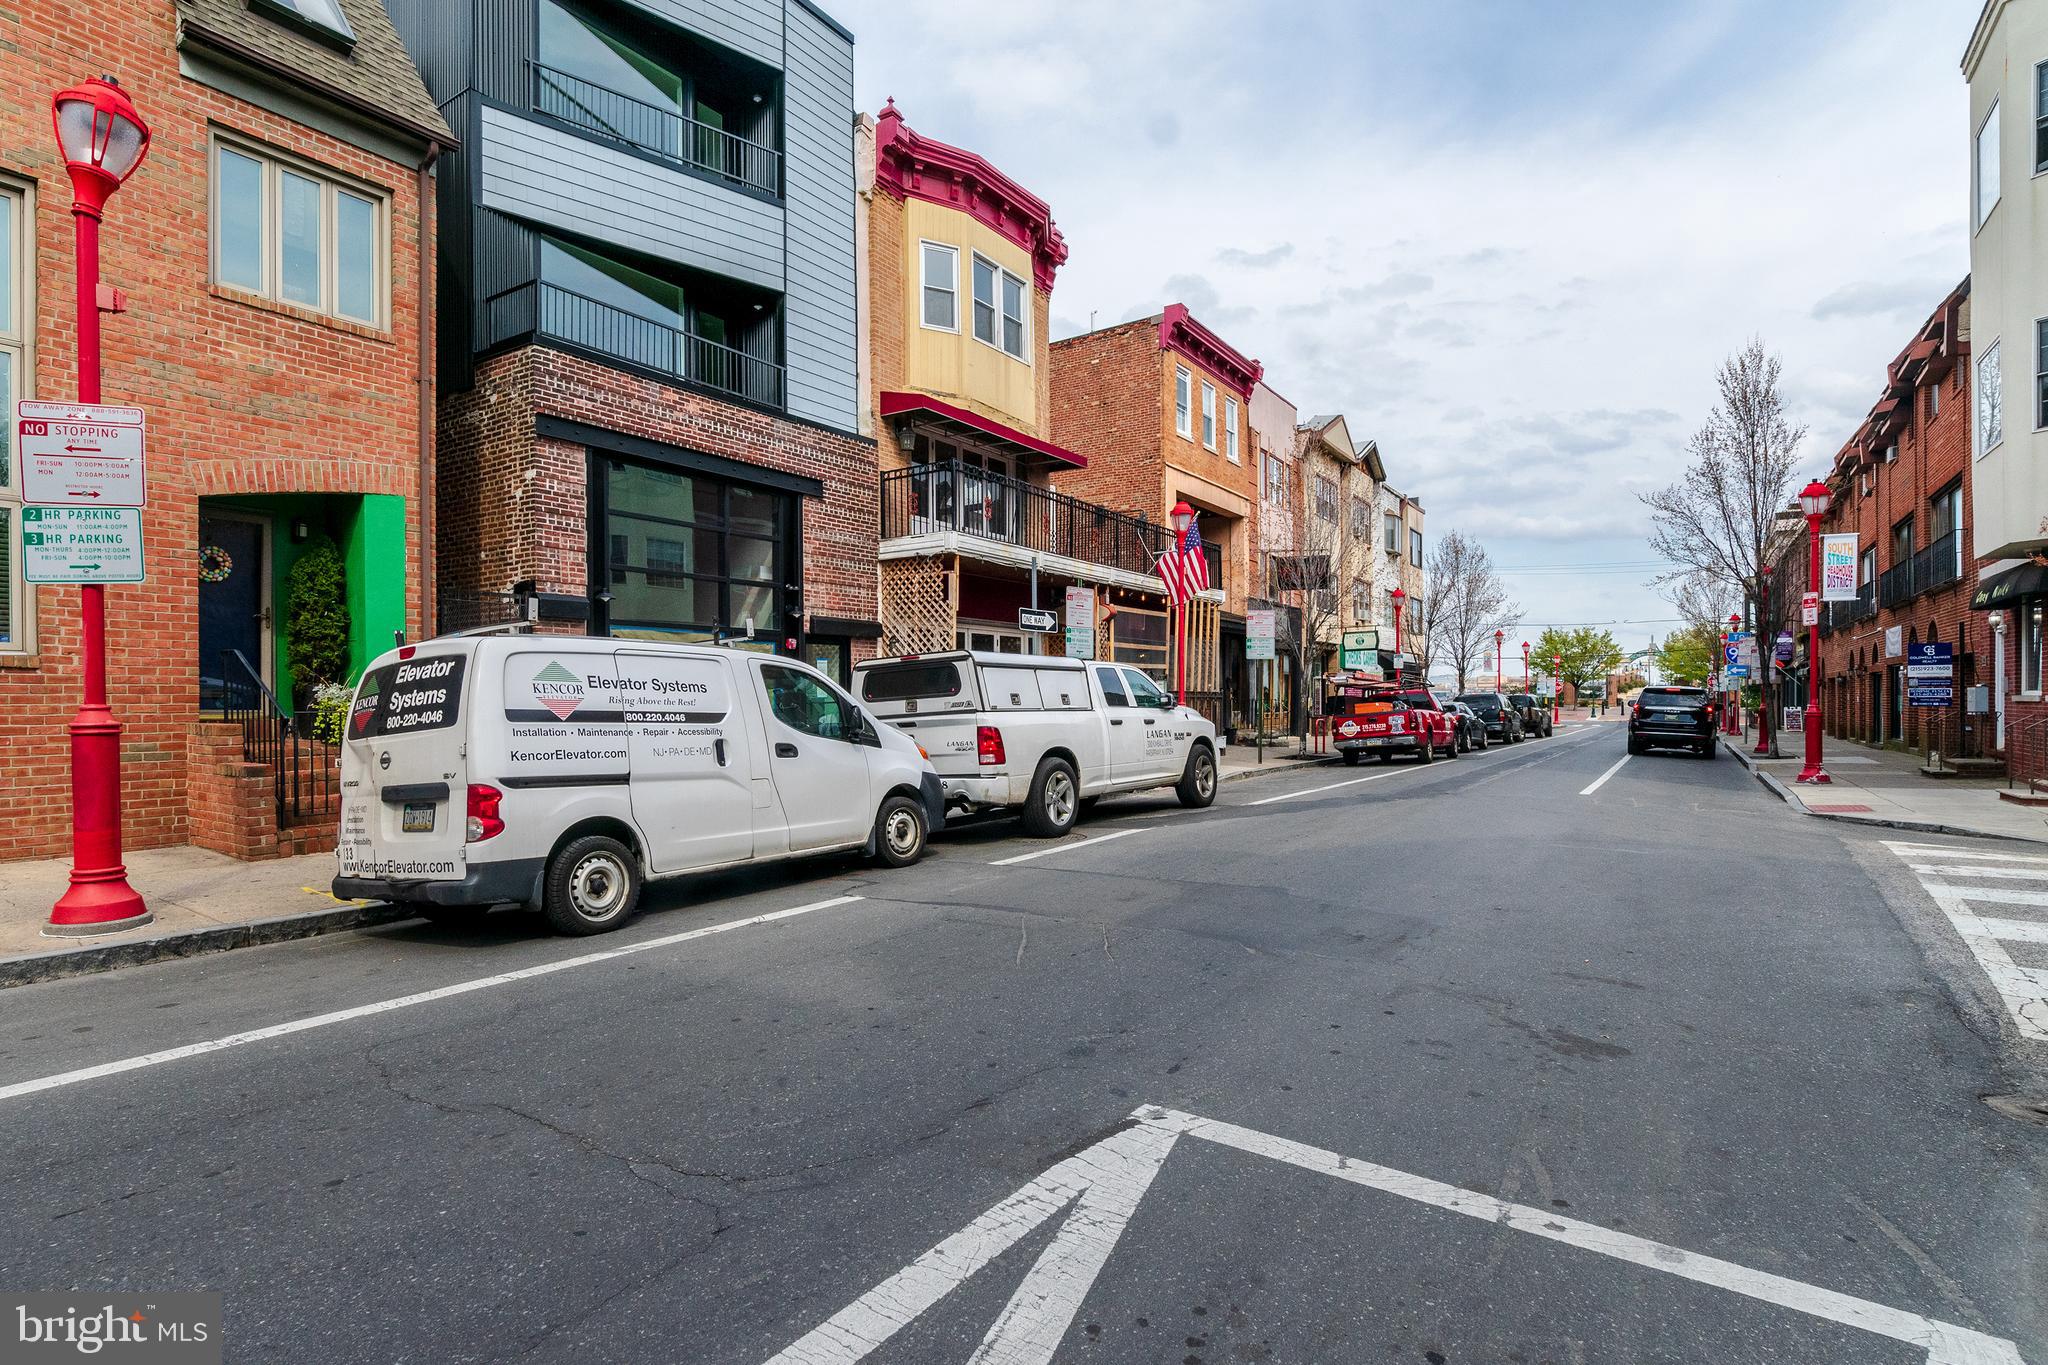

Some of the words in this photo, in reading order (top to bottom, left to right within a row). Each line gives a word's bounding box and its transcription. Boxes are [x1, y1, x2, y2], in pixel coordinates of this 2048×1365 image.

[25, 423, 45, 435] NO
[55, 425, 119, 439] STOPPING
[29, 510, 36, 520] 2
[44, 510, 60, 520] HR
[68, 510, 121, 520] PARKING
[31, 535, 38, 544] 3
[46, 534, 62, 544] HR
[69, 534, 123, 544] PARKING
[1827, 542, 1854, 556] SOUTH
[1827, 553, 1853, 565] STREET
[1827, 565, 1853, 578] HEADHOUSE
[1827, 574, 1853, 588] DISTRICT
[1023, 615, 1033, 624] ONE
[1034, 616, 1046, 624] WAY
[1729, 647, 1738, 660] 9
[395, 660, 456, 684] Elevator
[532, 683, 585, 695] KENCOR
[587, 675, 648, 691] Elevator
[651, 678, 708, 694] Systems
[355, 695, 379, 711] KENCOR
[389, 688, 447, 713] Systems
[608, 696, 635, 707] Rising
[637, 696, 661, 706] Above
[663, 697, 676, 706] the
[677, 698, 697, 706] Rest!
[386, 710, 444, 729] 800-220-4046
[626, 713, 686, 722] 800.220.4046
[512, 728, 567, 737] Installation
[577, 728, 634, 737] Maintenance
[643, 728, 669, 737] Repair
[677, 727, 723, 737] Accessibility
[1146, 729, 1172, 739] LANGAN
[510, 749, 627, 761] KencorElevator.com
